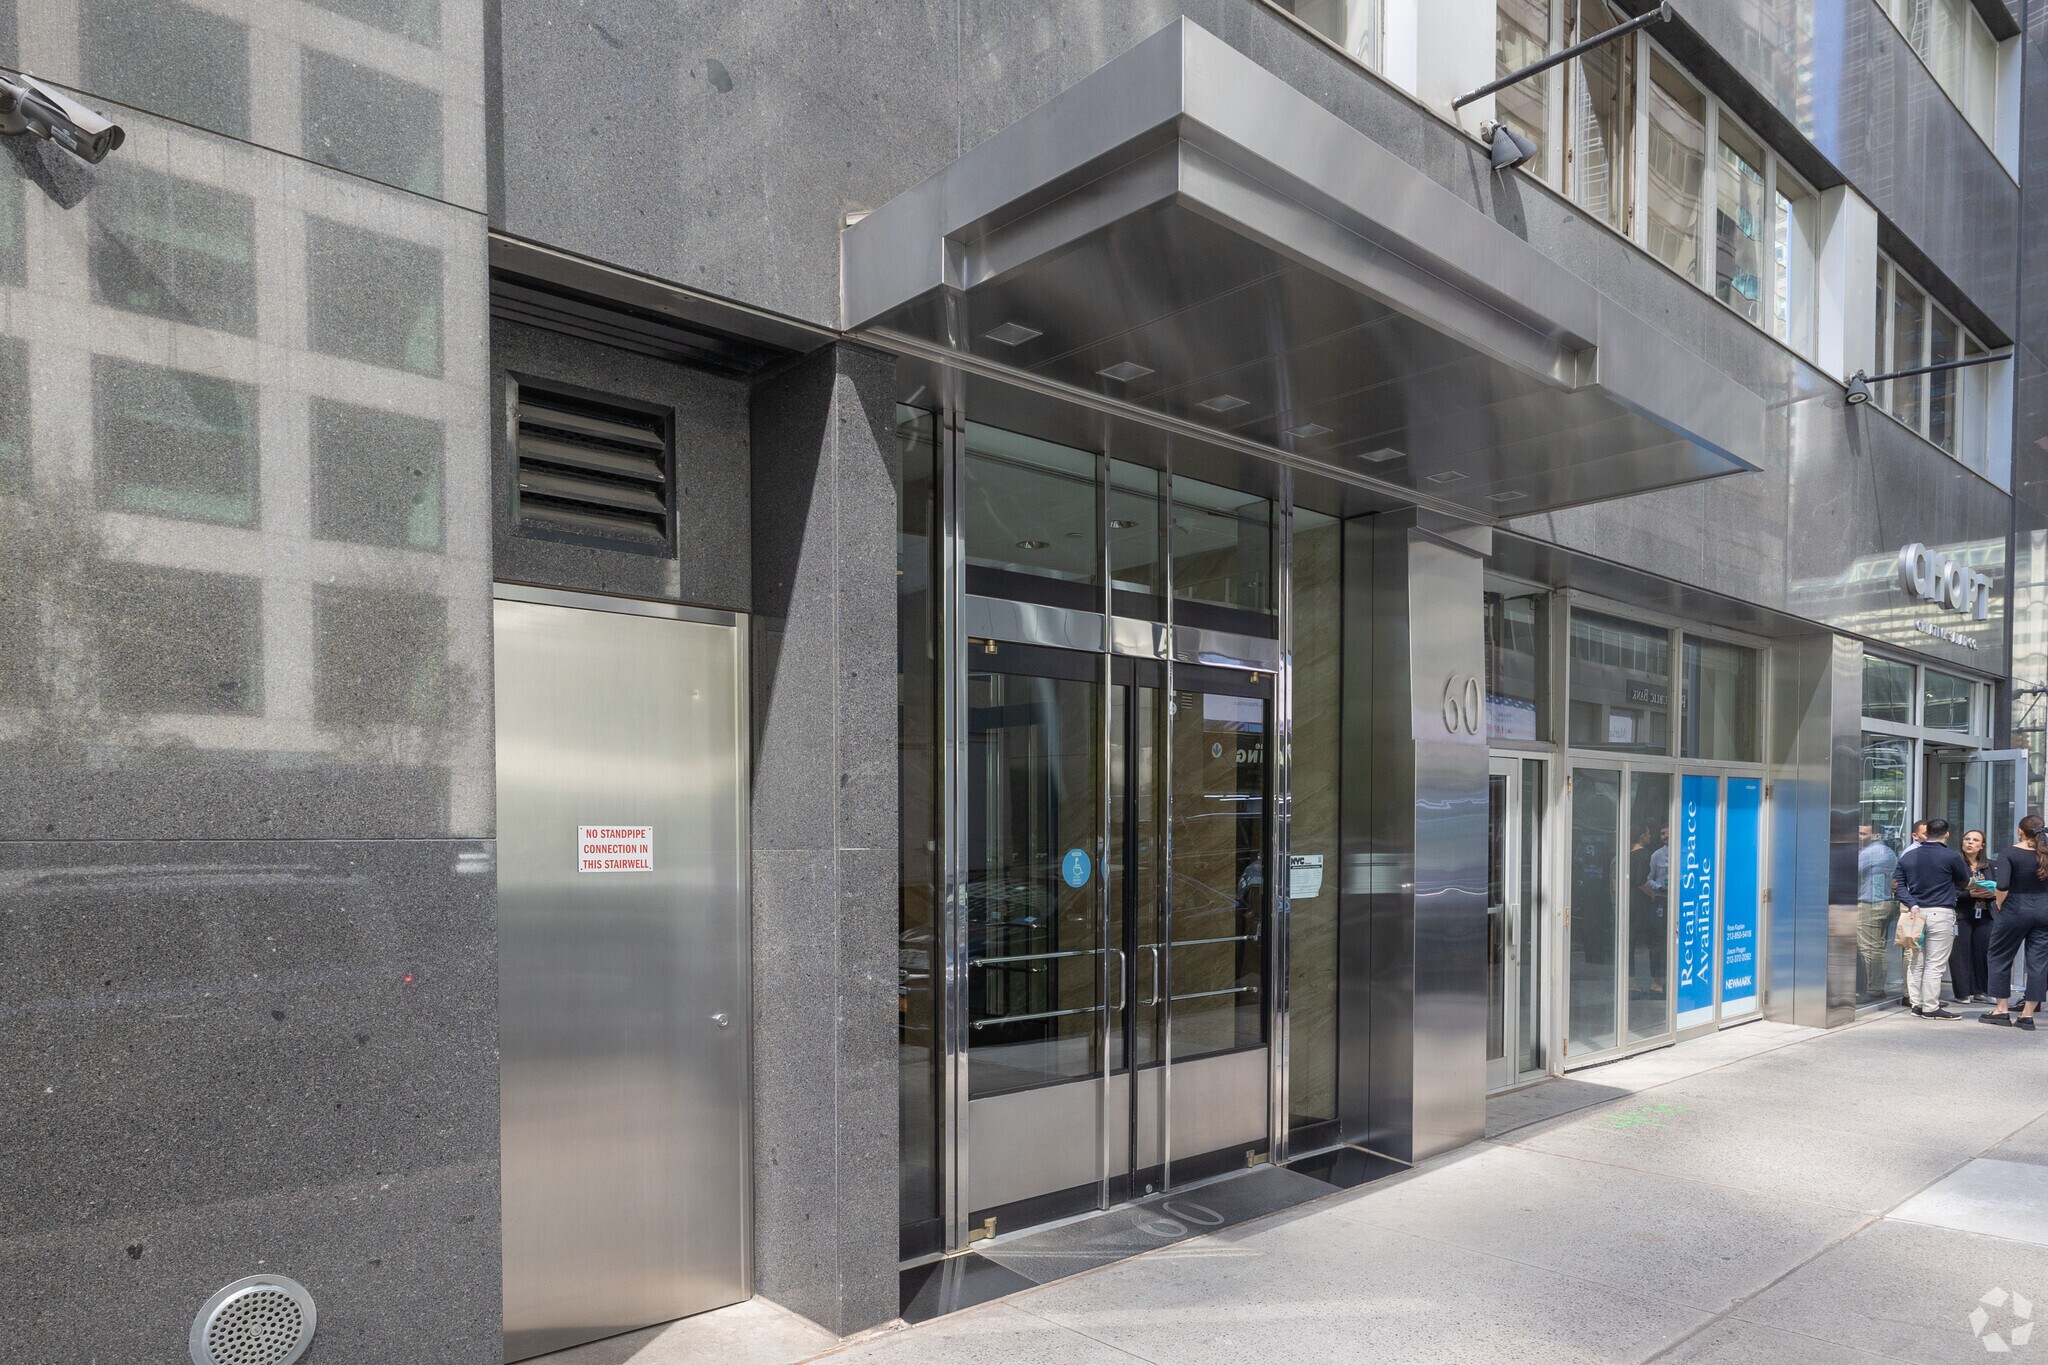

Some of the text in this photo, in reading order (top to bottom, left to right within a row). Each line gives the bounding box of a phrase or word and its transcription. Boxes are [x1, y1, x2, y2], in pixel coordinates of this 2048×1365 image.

[1905, 543, 1994, 620] CHOPT
[1443, 674, 1481, 735] 60
[586, 829, 646, 838] NO STANDPIPE
[583, 844, 648, 853] CONNECTION IN
[1290, 857, 1305, 865] NYC
[583, 859, 649, 869] THIS STAIRWELL
[1681, 801, 1698, 987] Retail Space
[1697, 858, 1711, 984] Available
[1725, 975, 1752, 990] NEWMARK
[1131, 1201, 1225, 1237] 60
